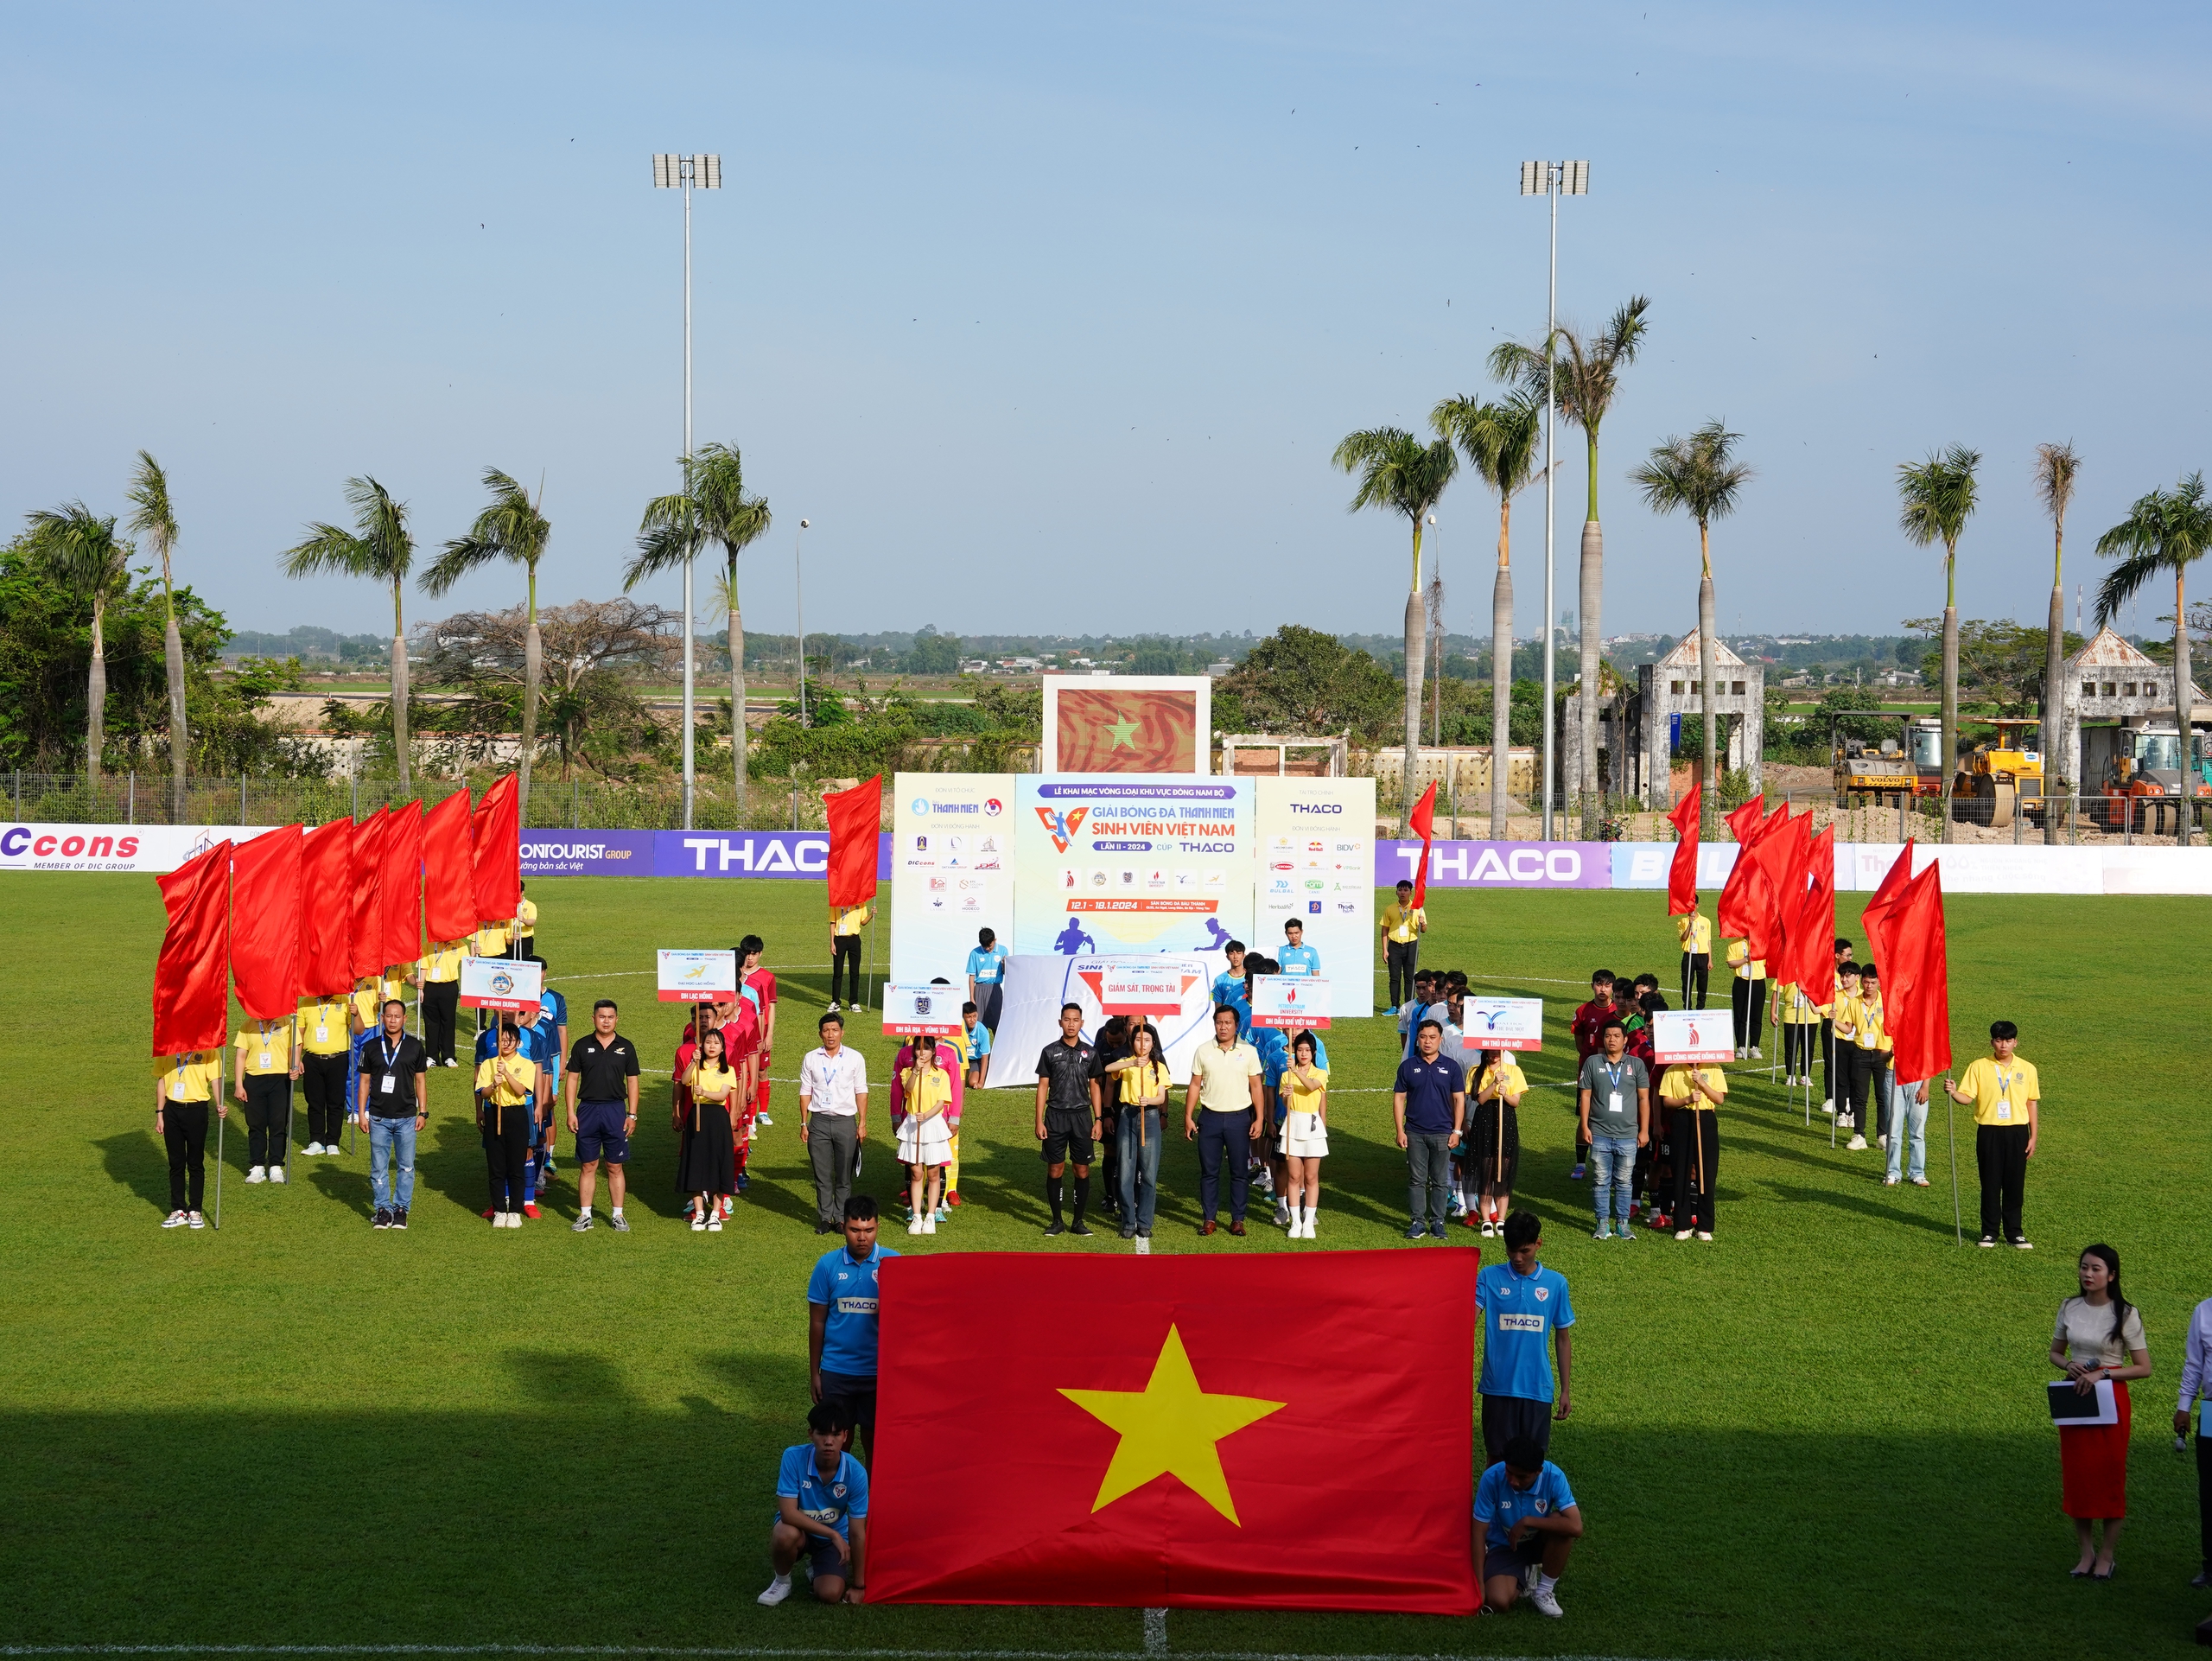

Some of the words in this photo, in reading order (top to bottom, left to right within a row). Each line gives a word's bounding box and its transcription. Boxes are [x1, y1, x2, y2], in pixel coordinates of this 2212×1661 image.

[1081, 788, 1097, 797] MẠC
[1099, 786, 1122, 796] VÒNG
[1122, 788, 1139, 797] LOẠI
[1155, 788, 1172, 797] VỰC
[1173, 787, 1194, 797] ĐÔNG
[1214, 787, 1224, 798] BỘ
[932, 804, 960, 813] THANH
[961, 804, 979, 813] NIÊN
[1092, 805, 1118, 818] GIẢI
[1121, 805, 1157, 818] BÓNG
[1160, 805, 1177, 818] ĐÁ
[1179, 807, 1211, 819] THANH
[1212, 806, 1235, 819] NIÊN
[1290, 804, 1342, 814] THACO
[1092, 823, 1127, 836] SINH
[1129, 820, 1163, 837] VIÊN
[1166, 821, 1196, 839] VIỆT
[1199, 824, 1235, 837] NAM
[1101, 842, 1116, 851] LẦN
[1157, 843, 1173, 851] CÚP
[1179, 843, 1235, 853] THACO
[605, 850, 632, 860] GROUP
[684, 838, 830, 873] THAC
[539, 862, 554, 870] bản
[556, 862, 569, 870] sắc
[569, 862, 584, 872] Việt
[1396, 848, 1581, 881] THACO
[1071, 901, 1086, 910] 12.1
[1095, 901, 1138, 911] 18.1.2024
[1109, 983, 1126, 993] GIÁM
[1127, 983, 1141, 994] SÁT,
[1142, 984, 1164, 995] TRỌNG
[1166, 983, 1175, 993] TÀI
[699, 991, 713, 1000] HỒNG
[489, 998, 502, 1007] BÌNH
[1294, 1018, 1306, 1027] VIỆT
[939, 1026, 949, 1034] TÀU
[1688, 1053, 1701, 1061] NGHỆ
[1661, 1144, 1670, 1155] 18
[842, 1301, 877, 1310] THACO
[1504, 1318, 1540, 1327] THACO
